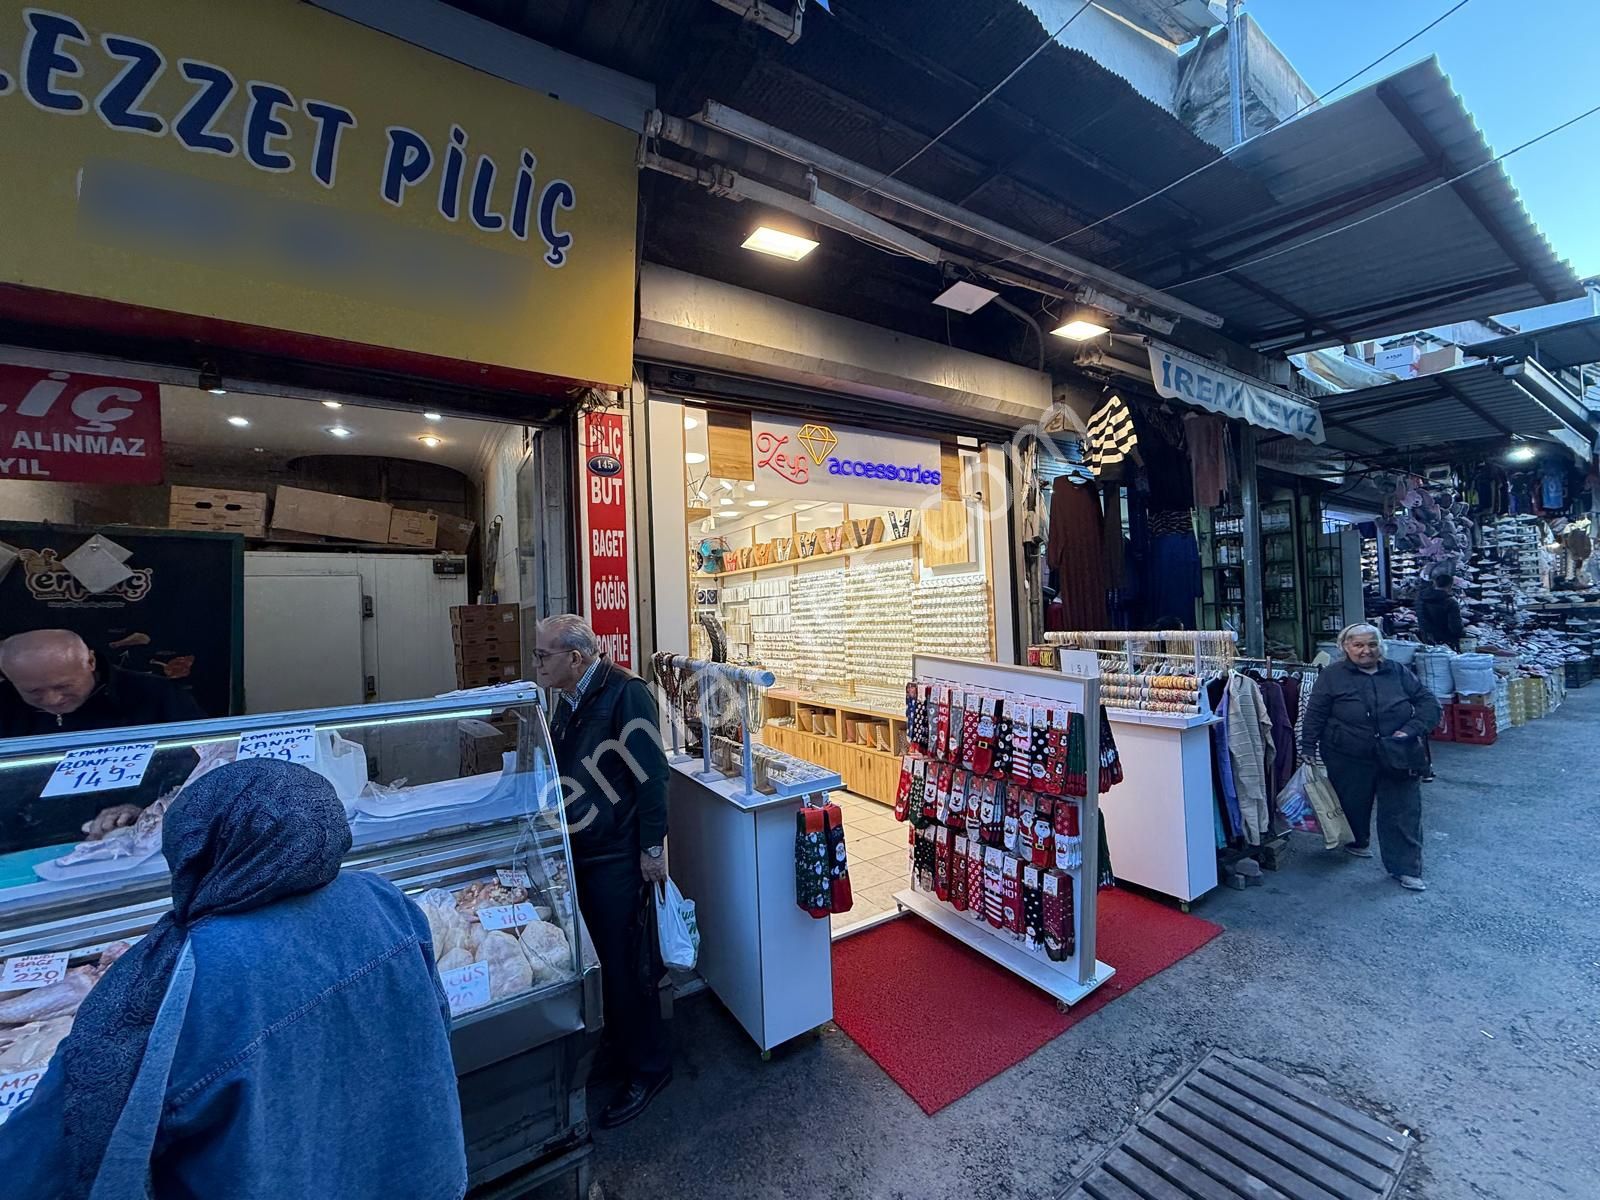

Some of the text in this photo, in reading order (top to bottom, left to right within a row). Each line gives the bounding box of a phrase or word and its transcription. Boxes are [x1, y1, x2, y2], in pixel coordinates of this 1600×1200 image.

[0, 7, 357, 188] EZZET
[380, 122, 576, 268] PİLİÇ
[11, 431, 146, 457] ALINMAZ
[589, 419, 621, 460] PİLİÇ
[597, 459, 615, 470] 145
[826, 456, 941, 486] accessories
[591, 476, 623, 506] BUT
[592, 529, 625, 558] BAGET
[594, 575, 627, 611] GÖĞÜS
[239, 735, 313, 754] KANAT
[73, 768, 126, 789] 149
[11, 970, 60, 984] 220
